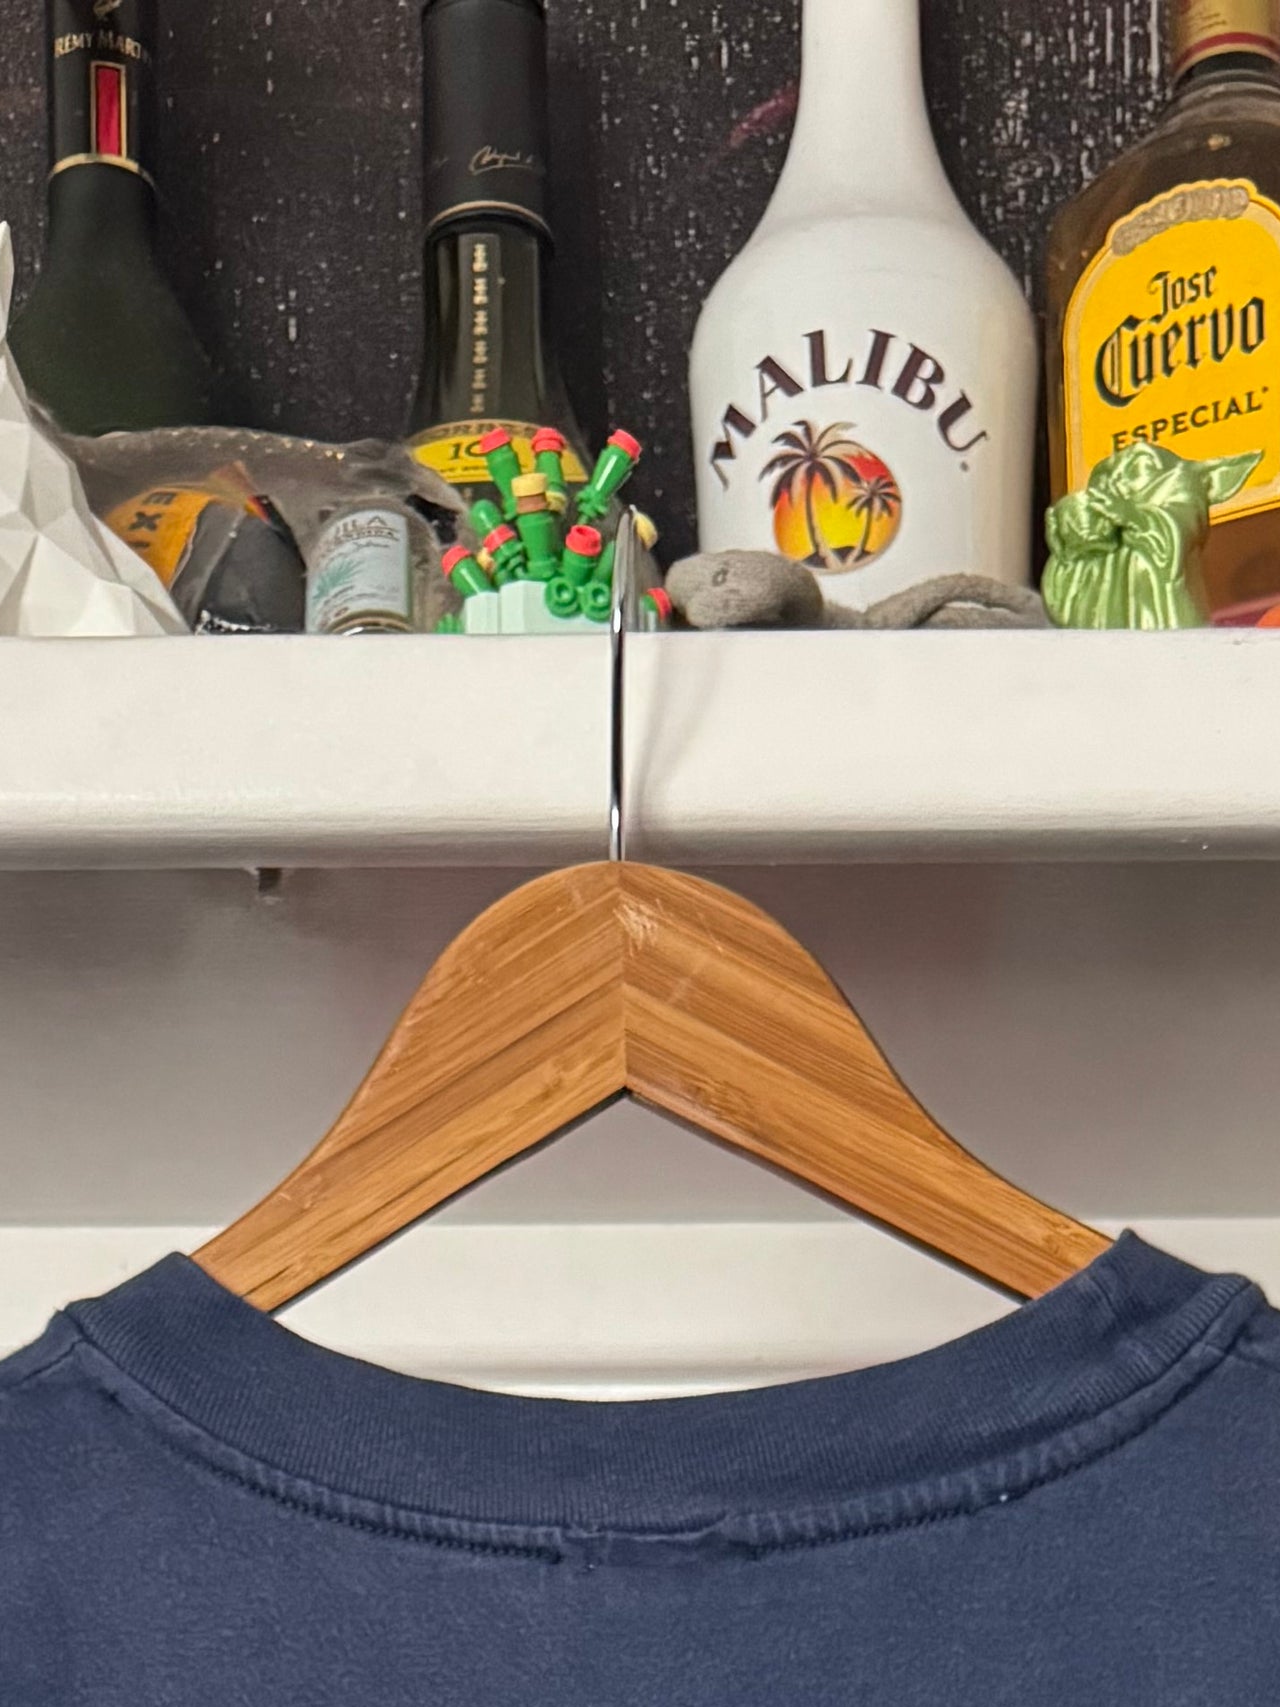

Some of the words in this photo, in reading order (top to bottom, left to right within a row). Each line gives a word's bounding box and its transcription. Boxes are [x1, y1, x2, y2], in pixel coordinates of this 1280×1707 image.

[1094, 296, 1266, 408] Cuervo
[709, 329, 988, 491] MALIBU
[1112, 388, 1264, 450] ESPECIAL
